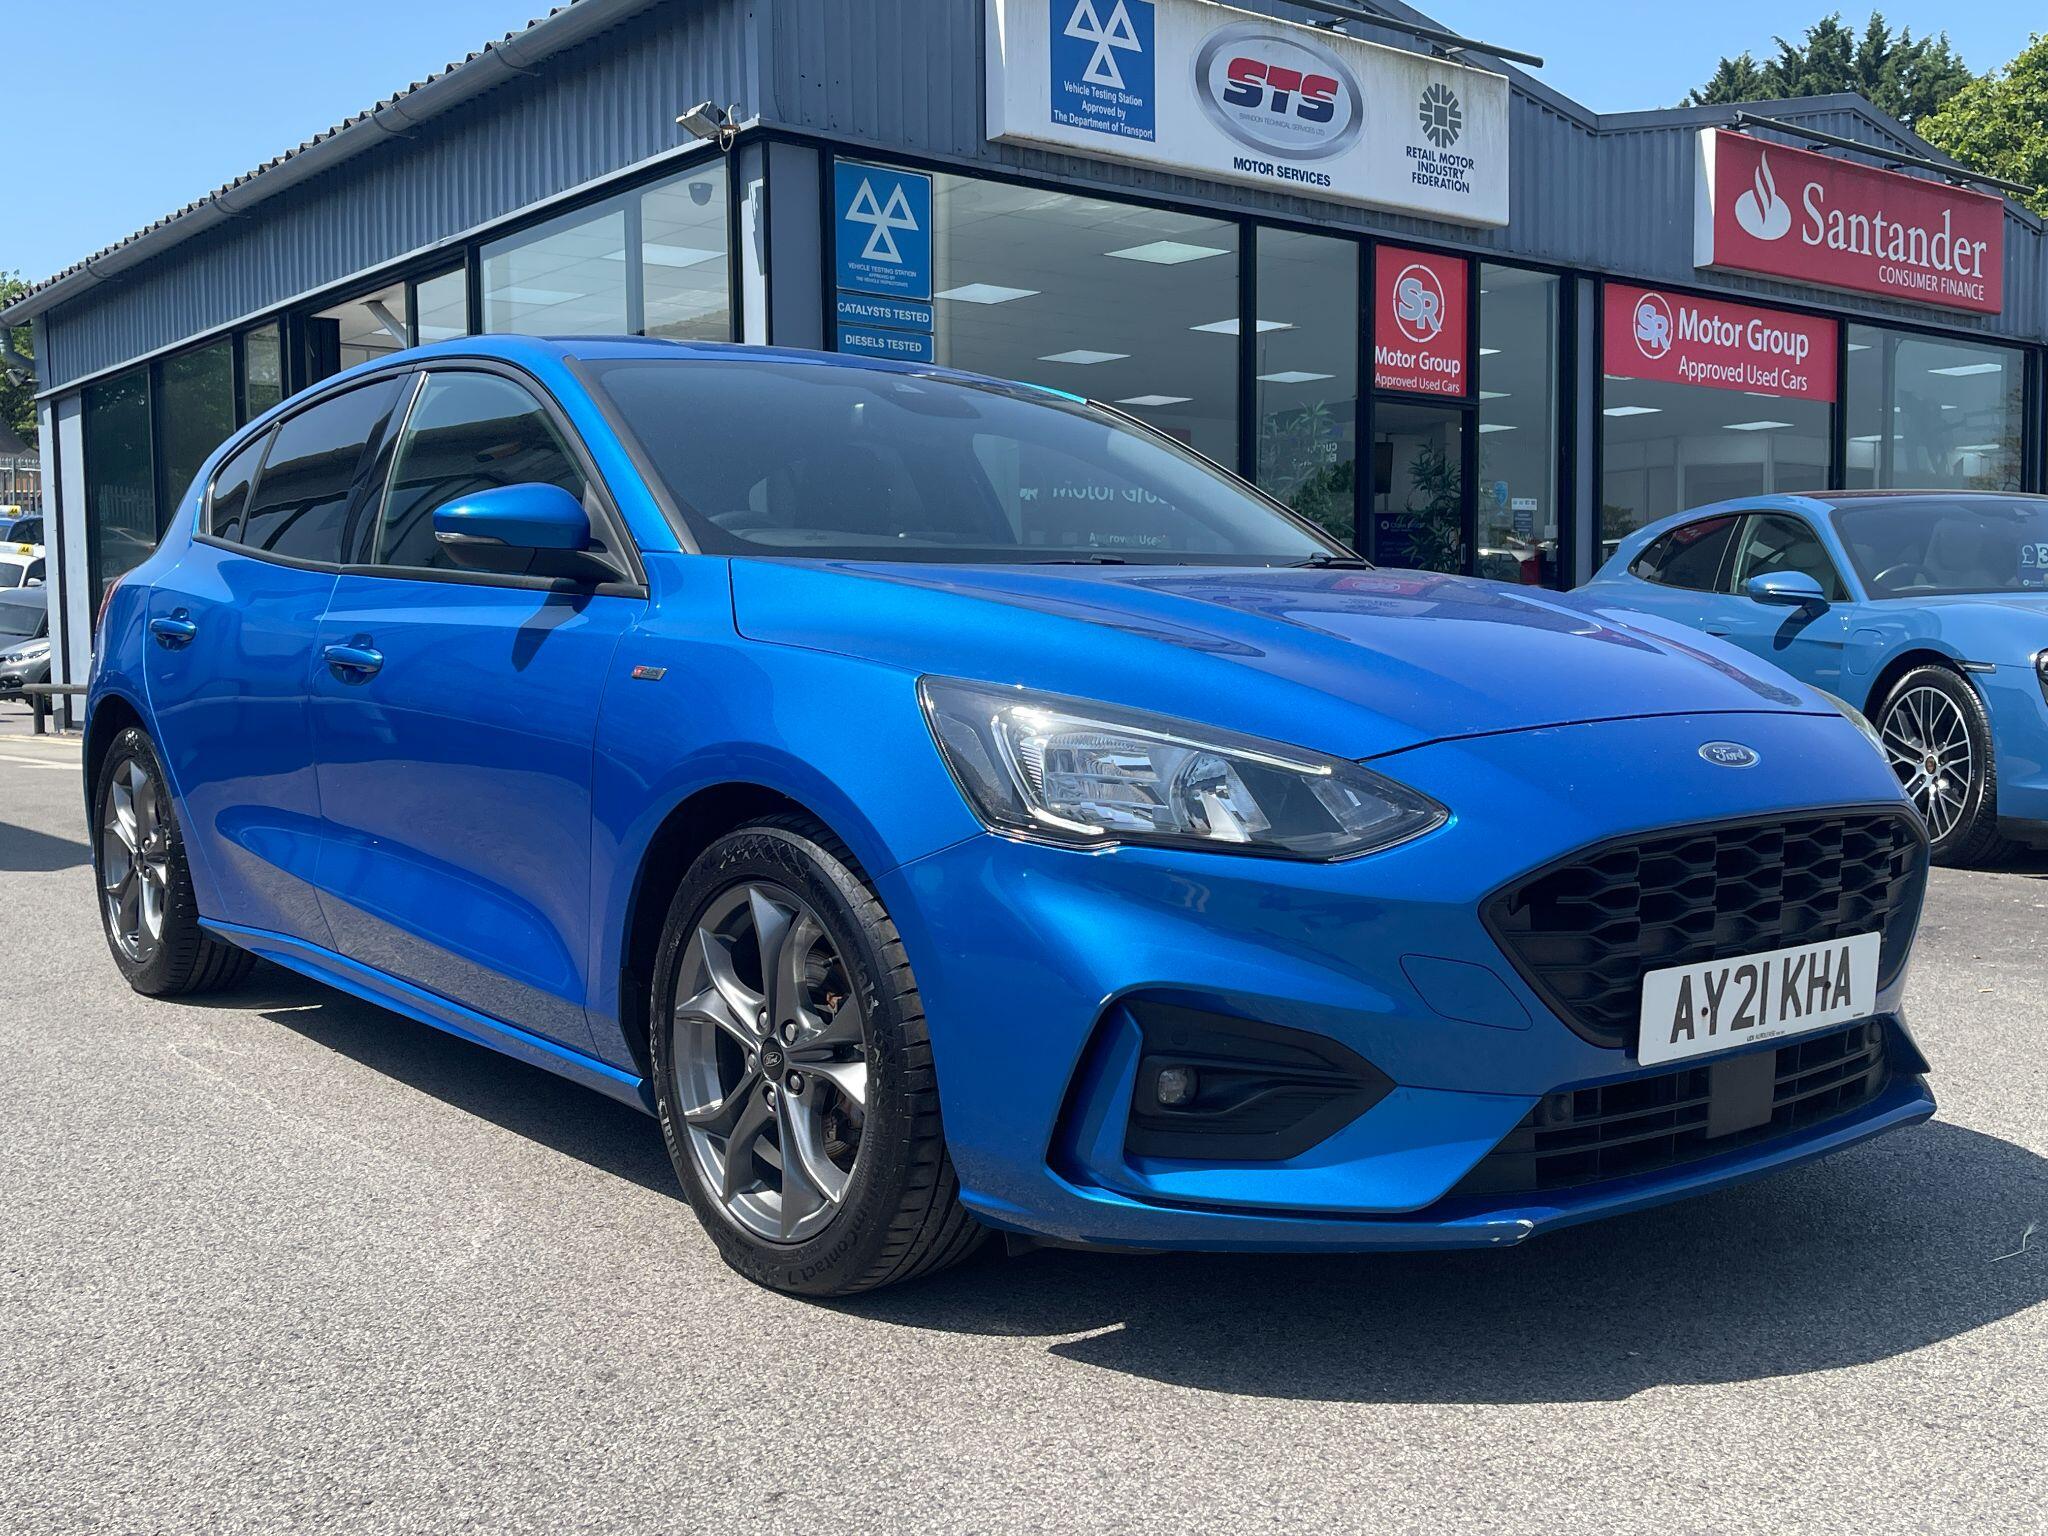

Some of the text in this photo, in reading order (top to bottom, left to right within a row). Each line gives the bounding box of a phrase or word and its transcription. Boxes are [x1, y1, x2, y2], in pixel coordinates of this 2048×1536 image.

[1064, 81, 1142, 107] Vehicle Testing Station
[1223, 57, 1339, 123] STS
[1054, 110, 1153, 139] The Department of Transport
[1082, 101, 1126, 120] Approved by
[1233, 157, 1331, 187] MOTOR SERVICES
[1406, 146, 1474, 170] RETAIL MOTOR
[1417, 160, 1465, 180] INDUSTRY
[1412, 171, 1470, 193] FEDERATION
[1802, 182, 1987, 278] Santander
[848, 262, 917, 278] VEHICLE TESTING STATION
[1878, 265, 1984, 301] CONSUMER FINANCE
[837, 302, 930, 323] CATALYSTS TESTED
[1399, 277, 1442, 332] SR
[1637, 303, 1671, 351] SR
[1678, 307, 1809, 364] Motor Group
[845, 334, 922, 352] DIESELS TESTED
[1375, 345, 1461, 378] Motor Group
[1678, 355, 1808, 391] Approved Used Cars
[1375, 373, 1460, 393] Approved Used Cars
[1712, 746, 1747, 761] Ford
[1669, 946, 1851, 1044] AY21 KHA
